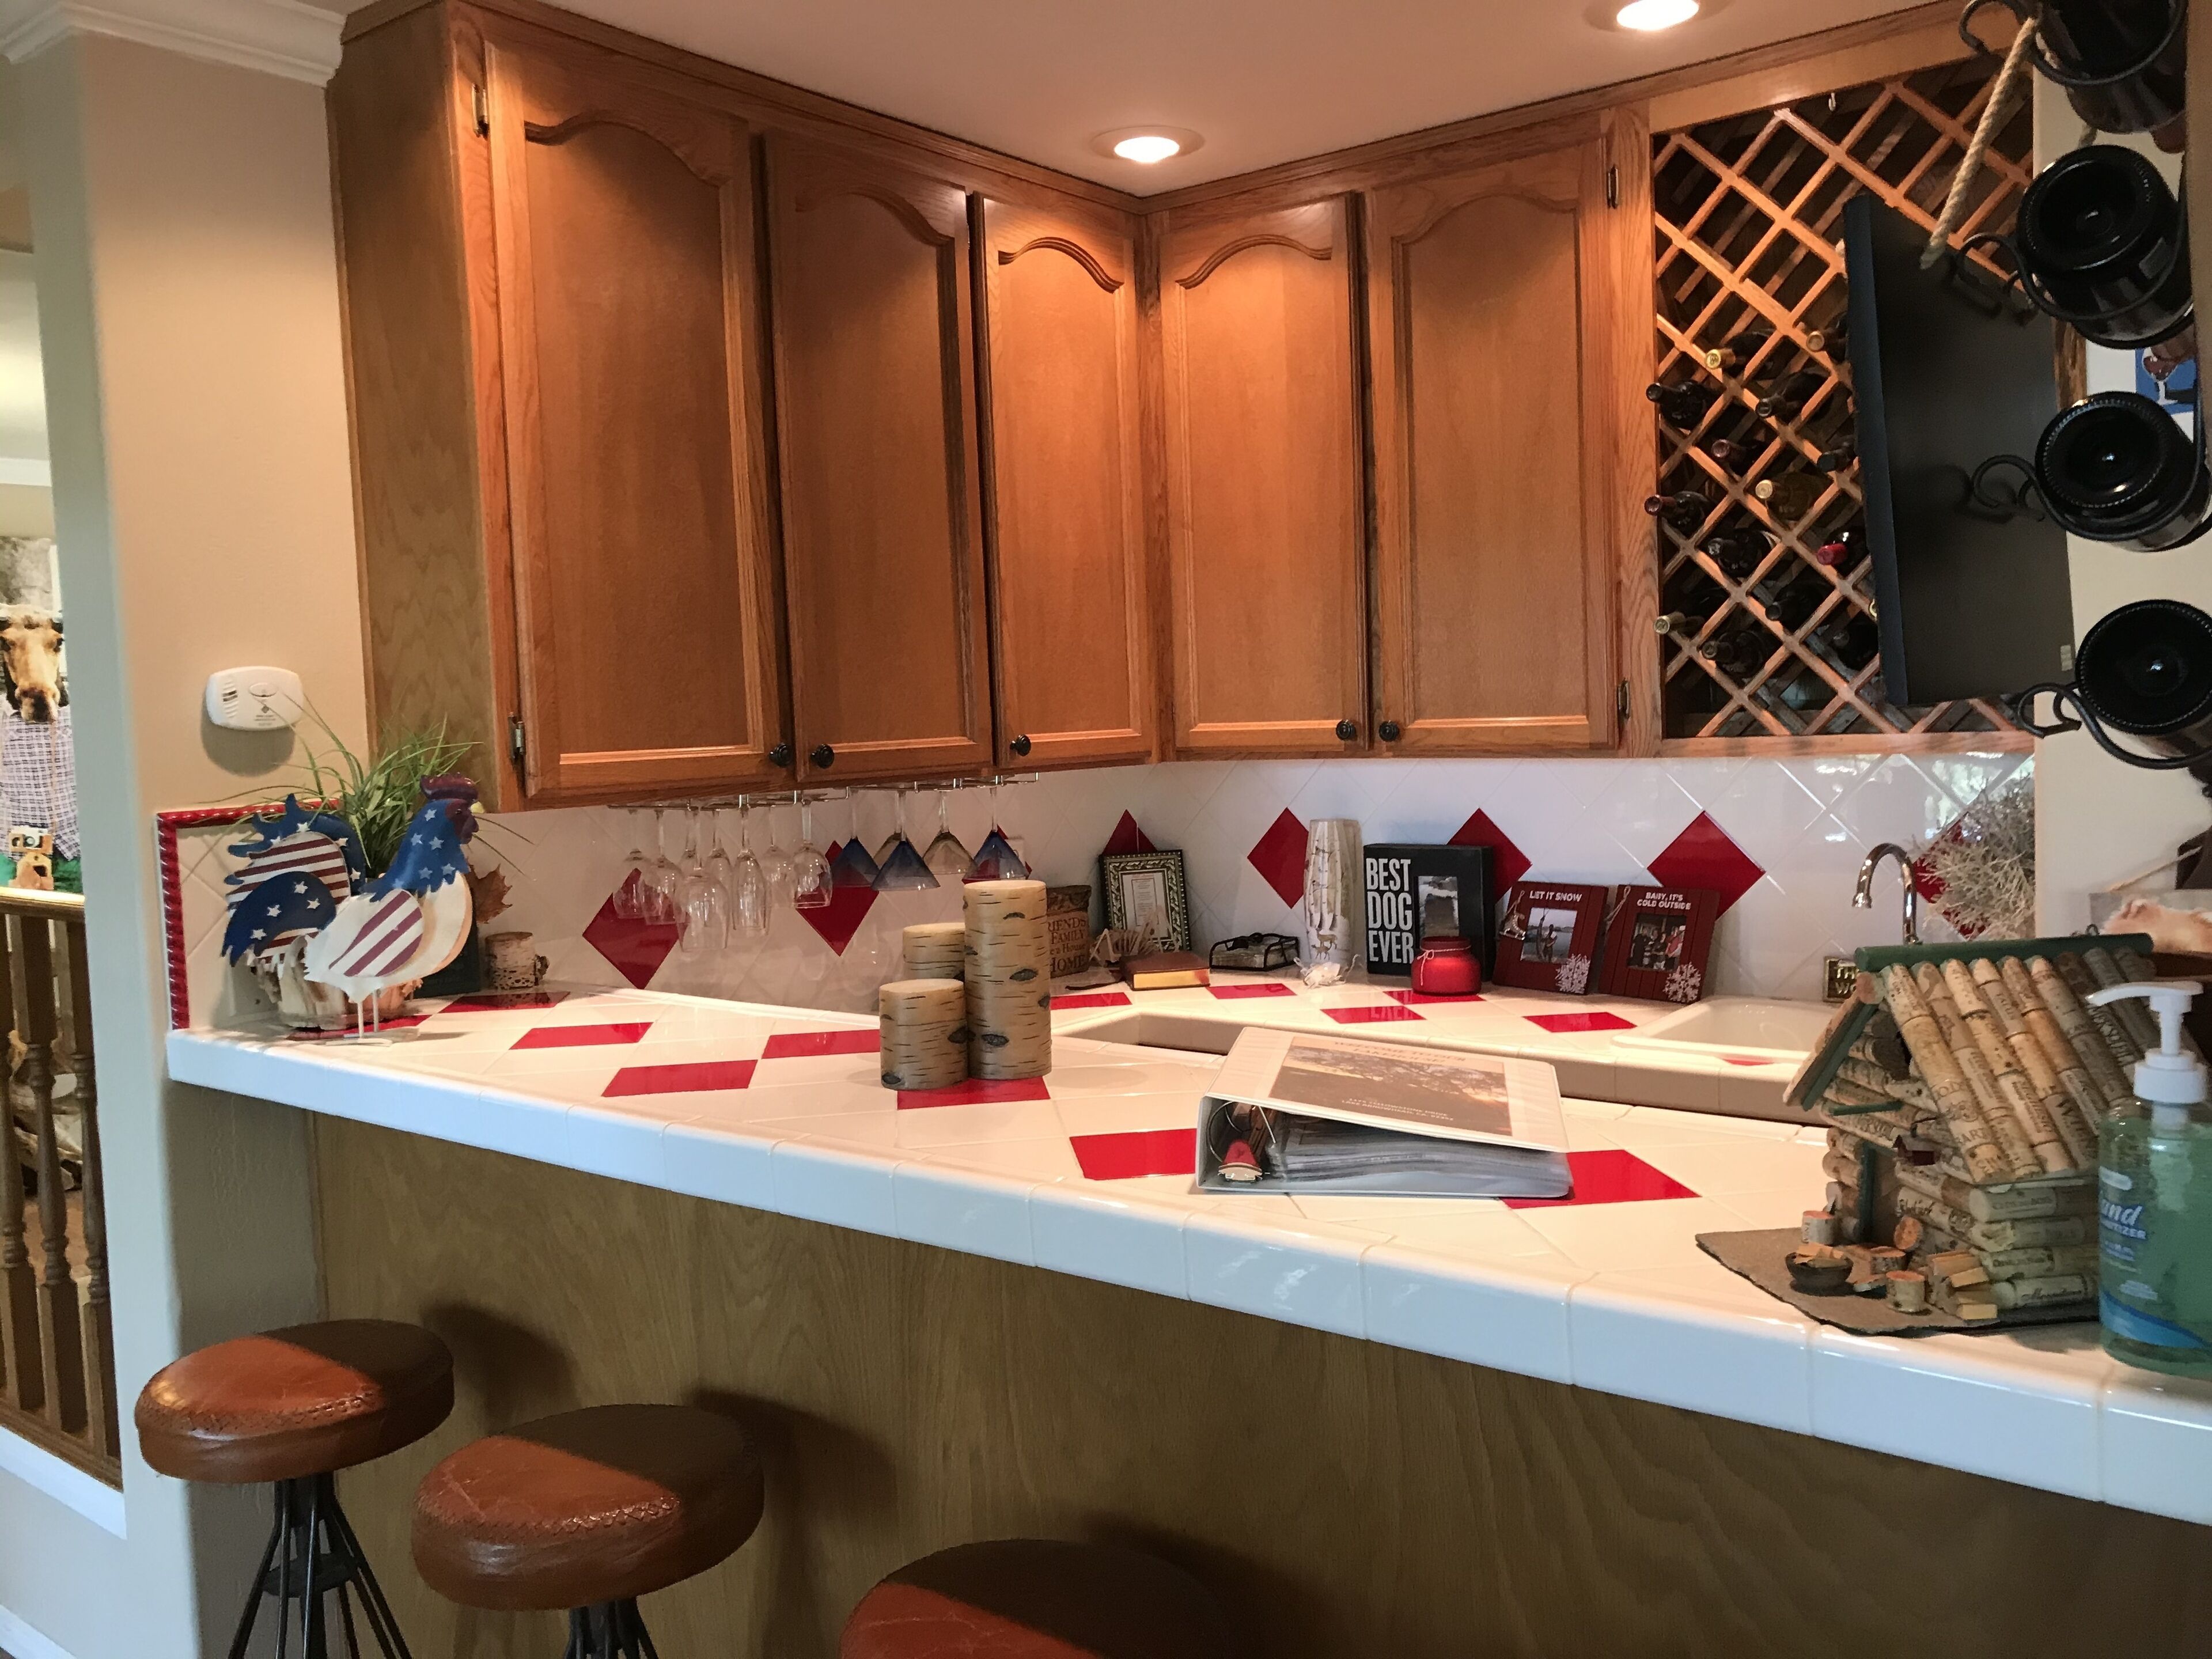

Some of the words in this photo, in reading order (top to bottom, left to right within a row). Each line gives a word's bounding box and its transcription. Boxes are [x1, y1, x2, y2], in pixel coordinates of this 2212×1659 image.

[1366, 858, 1411, 891] BEST
[1529, 890, 1545, 899] LET
[1546, 891, 1555, 900] IT
[1555, 892, 1582, 902] SNOW
[1637, 899, 1657, 907] COLD
[1658, 900, 1692, 910] OUTSIDE
[1367, 891, 1412, 930] DOG
[1048, 917, 1086, 932] RIENDS
[1051, 929, 1085, 945] FAMILY
[1368, 930, 1415, 964] EVER
[2100, 1198, 2143, 1226] and
